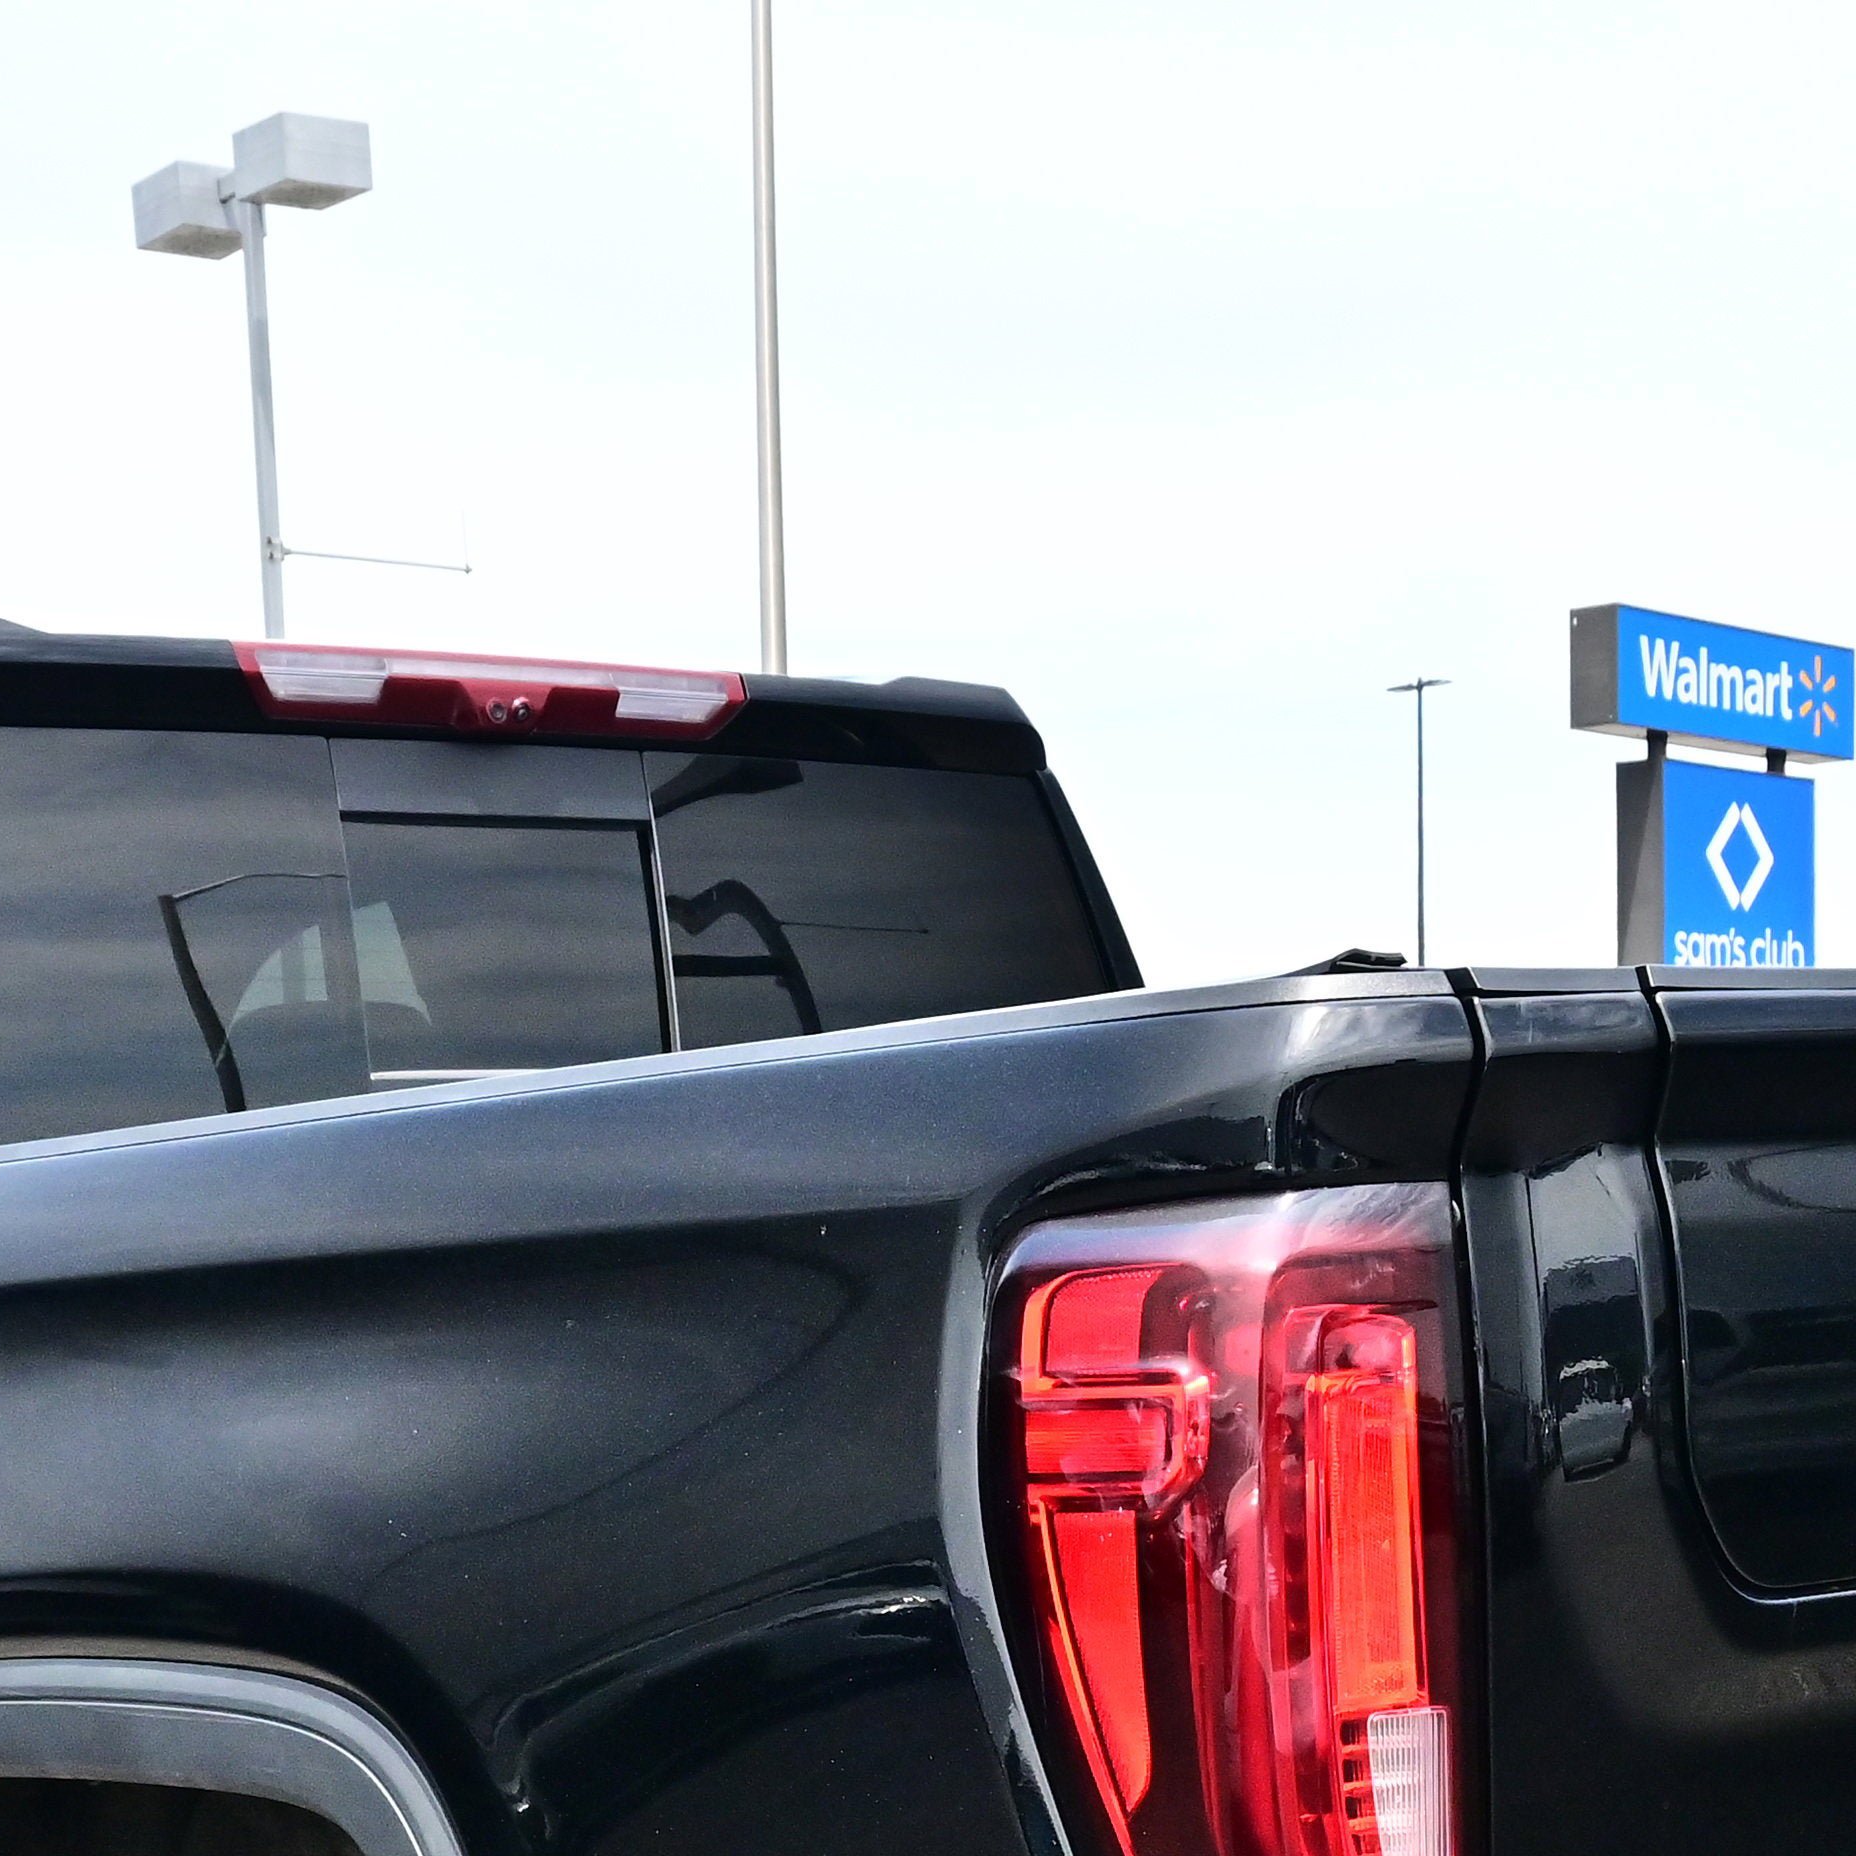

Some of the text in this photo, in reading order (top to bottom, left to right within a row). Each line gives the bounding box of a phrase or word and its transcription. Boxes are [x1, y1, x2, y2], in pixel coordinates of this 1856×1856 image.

[1639, 634, 1793, 720] Walmart
[1673, 926, 1805, 967] sam's club
